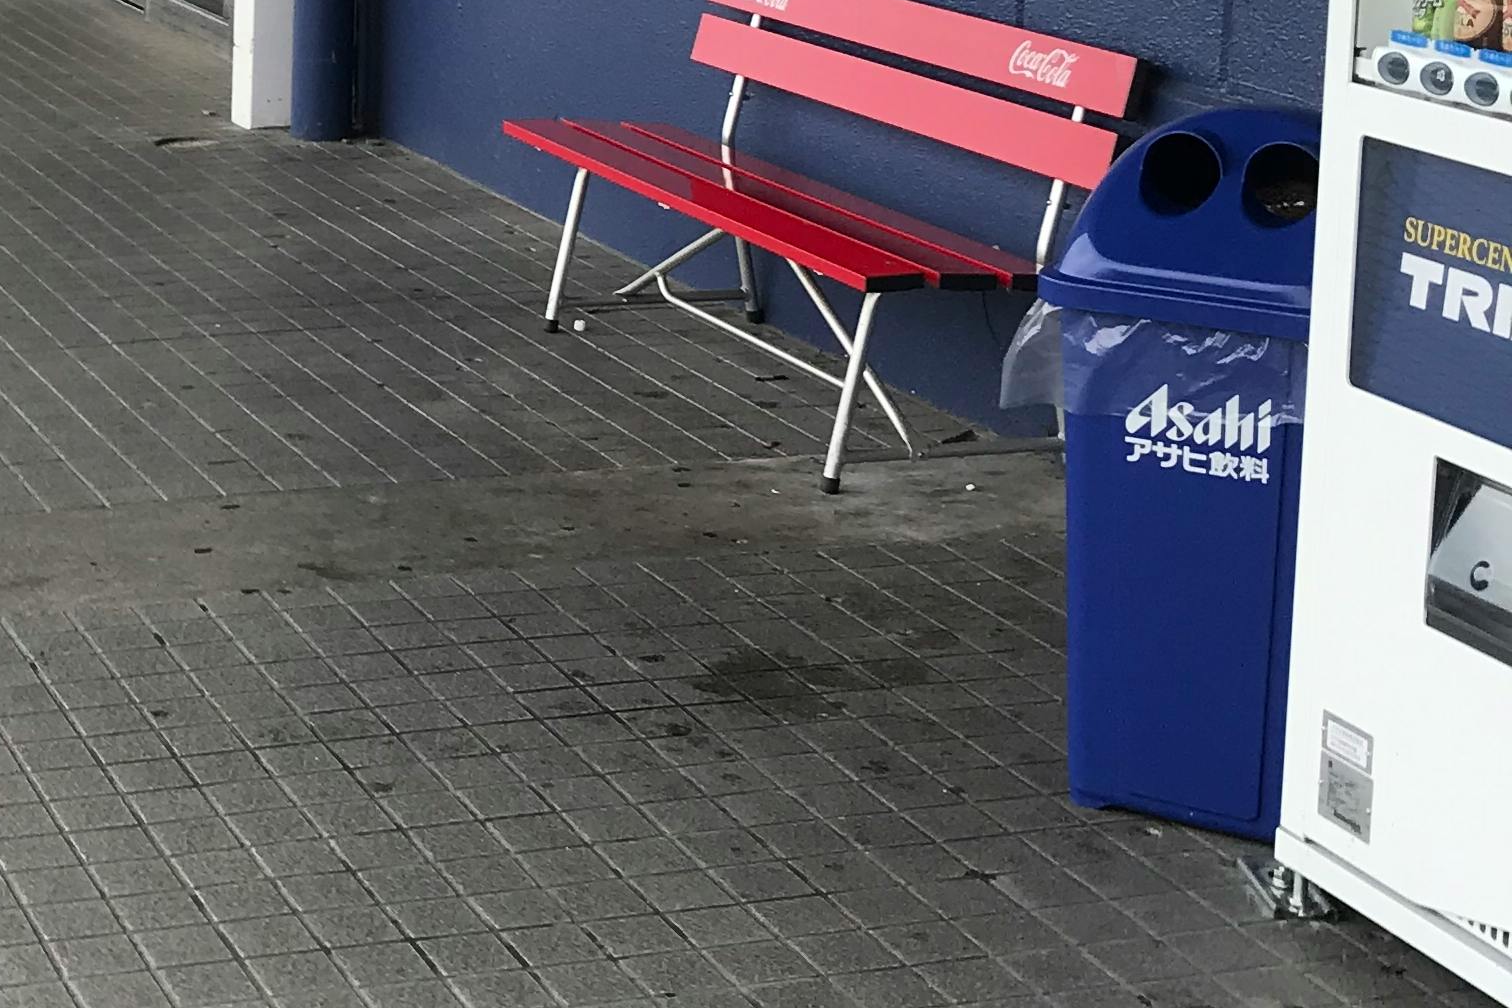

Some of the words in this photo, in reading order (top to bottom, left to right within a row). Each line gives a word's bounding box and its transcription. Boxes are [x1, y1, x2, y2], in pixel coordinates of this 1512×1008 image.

[1125, 383, 1272, 453] Asahi
[1124, 436, 1270, 484] アサヒ飲料
